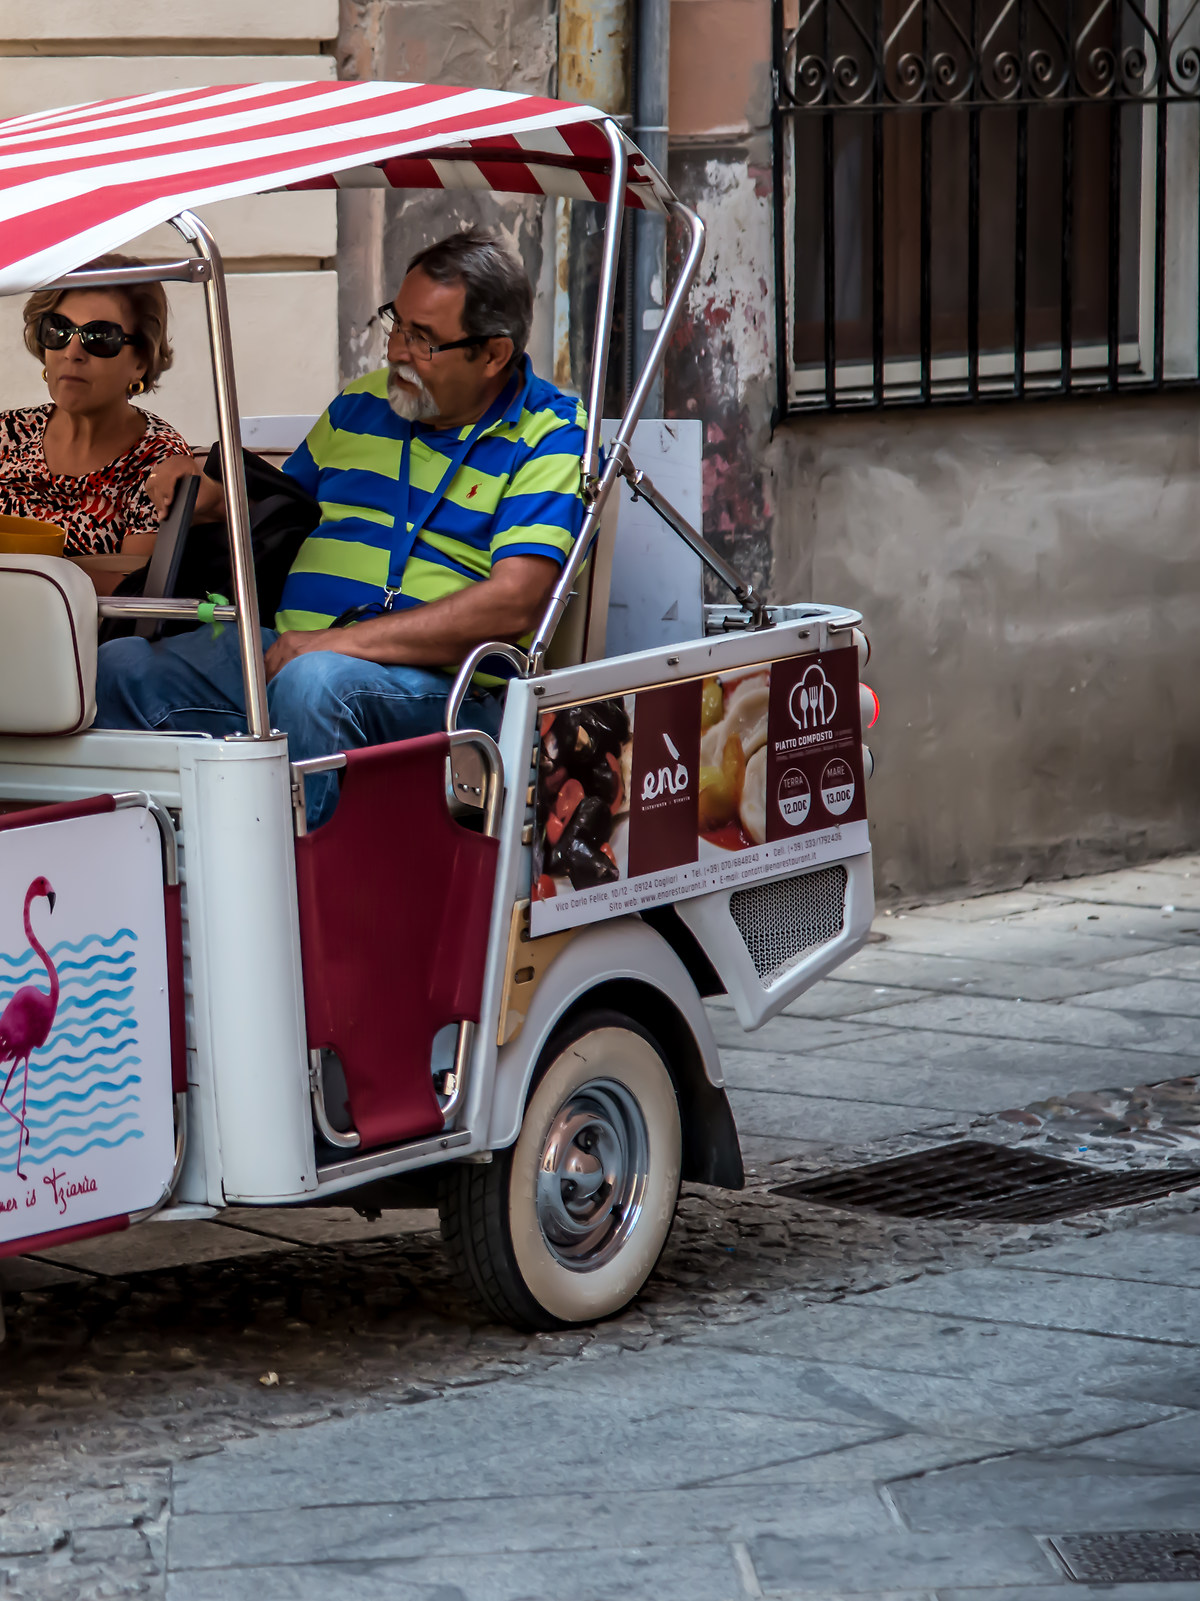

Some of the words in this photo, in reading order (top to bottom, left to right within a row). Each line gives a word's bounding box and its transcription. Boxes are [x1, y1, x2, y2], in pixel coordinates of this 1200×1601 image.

[775, 738, 797, 752] PIATTO
[798, 730, 833, 746] COMPOSTO
[827, 765, 846, 778] MARE
[783, 776, 804, 788] TERRA
[826, 789, 851, 804] 13.00€
[784, 799, 808, 814] 12.00€
[555, 901, 569, 912] Vico
[570, 898, 587, 909] Carlo
[634, 882, 652, 893] 09124
[654, 874, 678, 890] Cagliari
[609, 901, 622, 912] Sito
[26, 1188, 36, 1208] is
